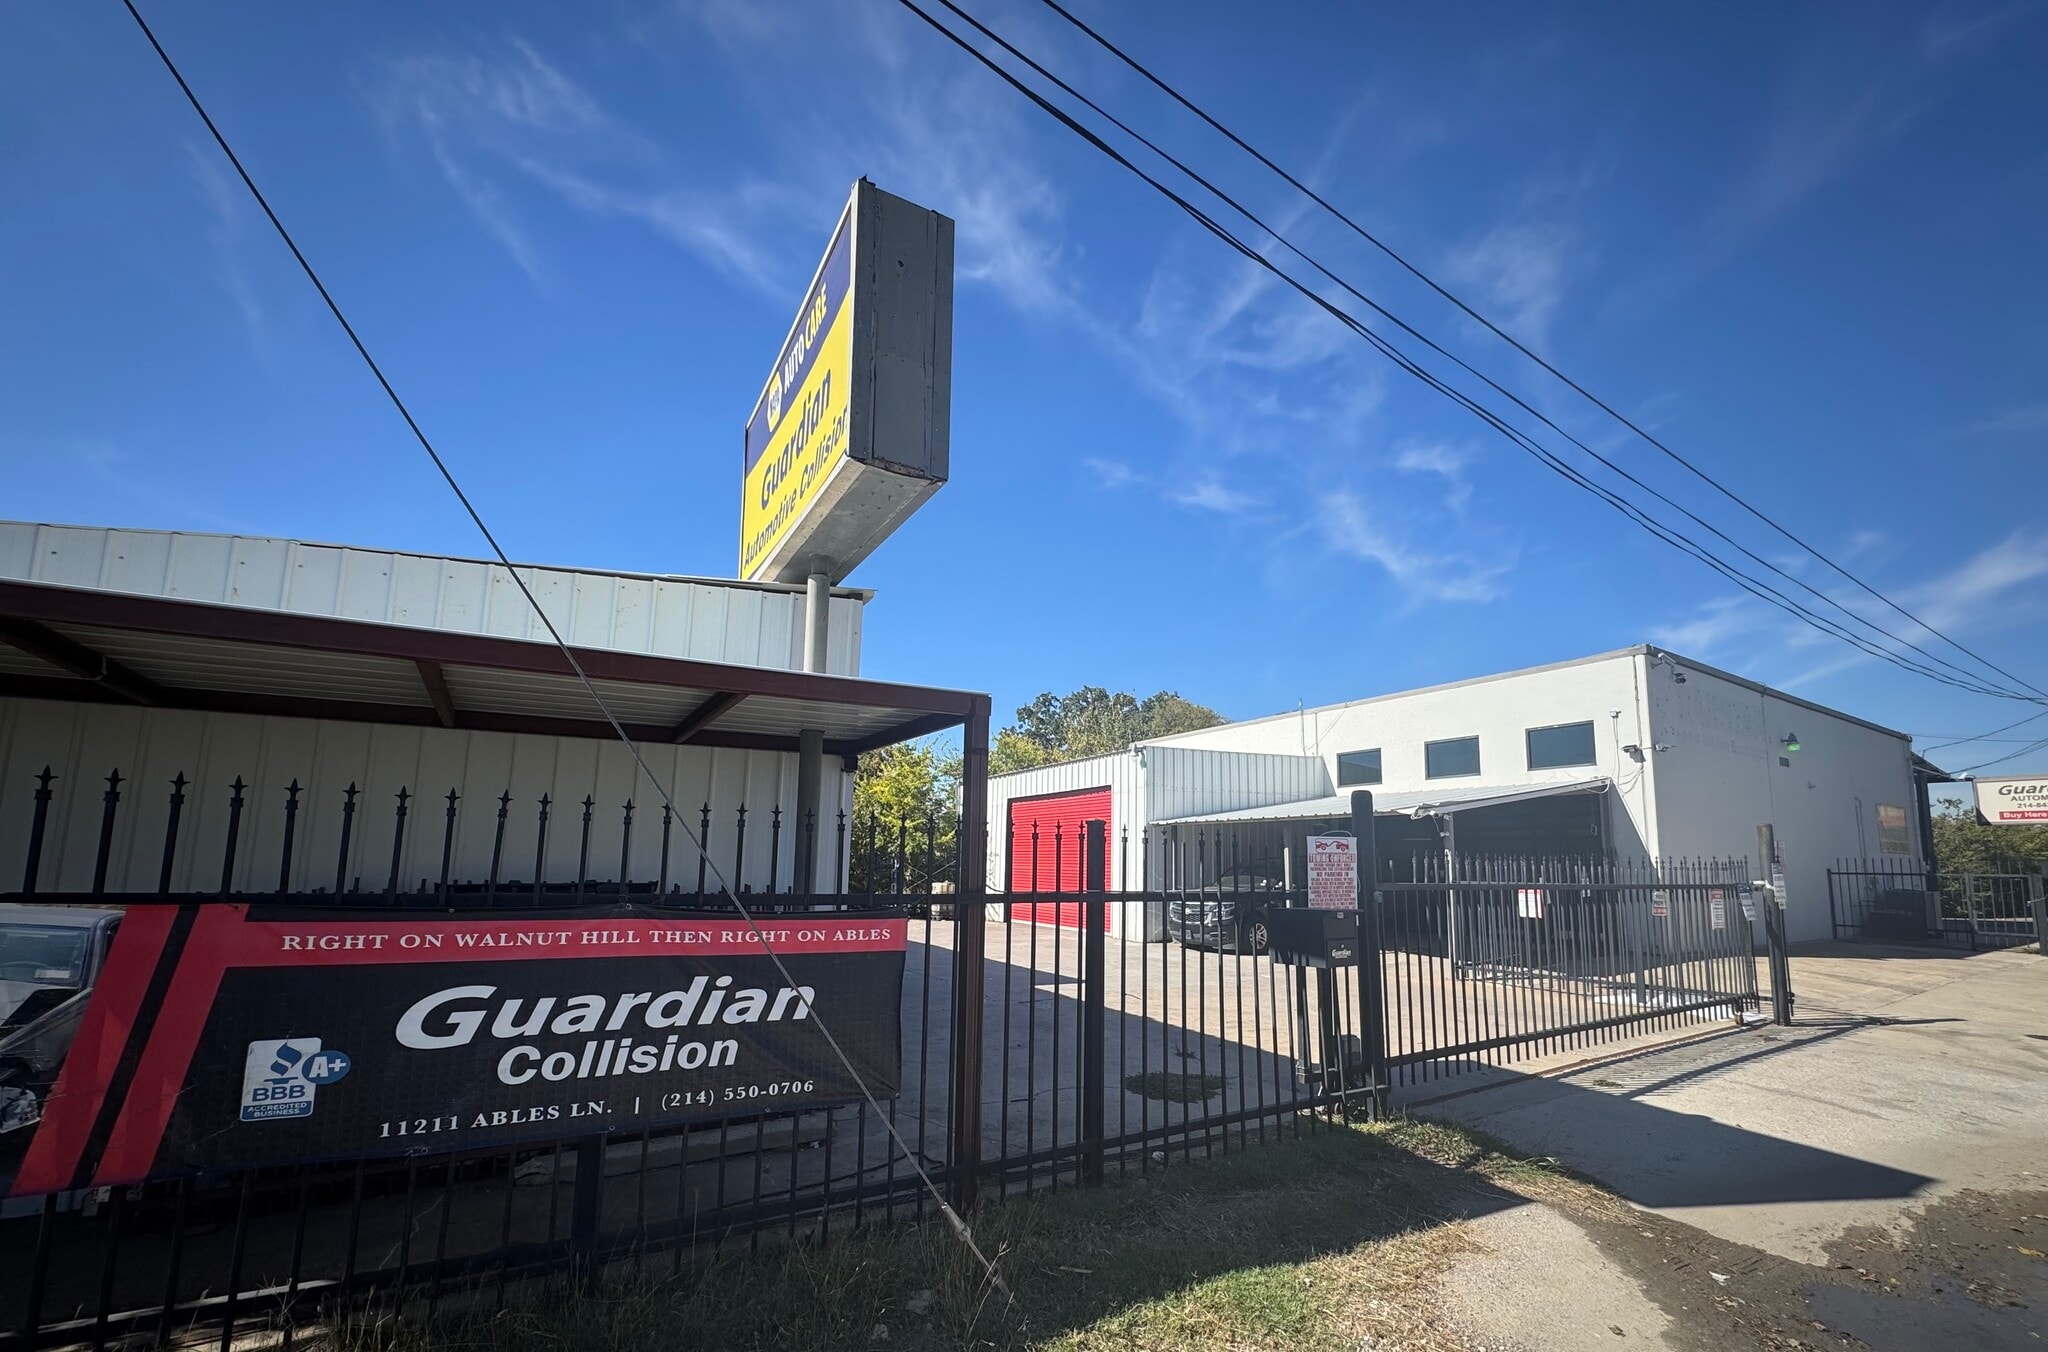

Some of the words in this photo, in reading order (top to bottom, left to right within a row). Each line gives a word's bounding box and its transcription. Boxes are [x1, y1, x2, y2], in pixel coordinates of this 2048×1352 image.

[784, 333, 805, 394] AUTO
[805, 282, 827, 350] CARE
[761, 368, 831, 511] Guardian
[744, 488, 797, 570] Automotive
[1998, 785, 2048, 796] Guar
[282, 935, 388, 950] RIGHT
[399, 934, 445, 948] ON
[455, 932, 572, 947] WALNUT
[580, 930, 641, 945] HILL
[649, 930, 713, 944] THEN
[720, 930, 791, 943] RIGHT
[797, 929, 827, 942] ON
[832, 928, 892, 941] ABLES
[396, 975, 816, 1050] Guardian
[308, 1056, 347, 1078] A+
[497, 1034, 739, 1086] Collision
[247, 1102, 308, 1112] ACCREDITED
[252, 1085, 306, 1102] BBB
[379, 1115, 460, 1138] 11211
[470, 1104, 561, 1129] ABLES
[570, 1099, 612, 1119] LN.
[661, 1089, 716, 1112] (214)
[723, 1080, 815, 1101] 550-0706
[254, 1108, 300, 1118] BUSINESS
